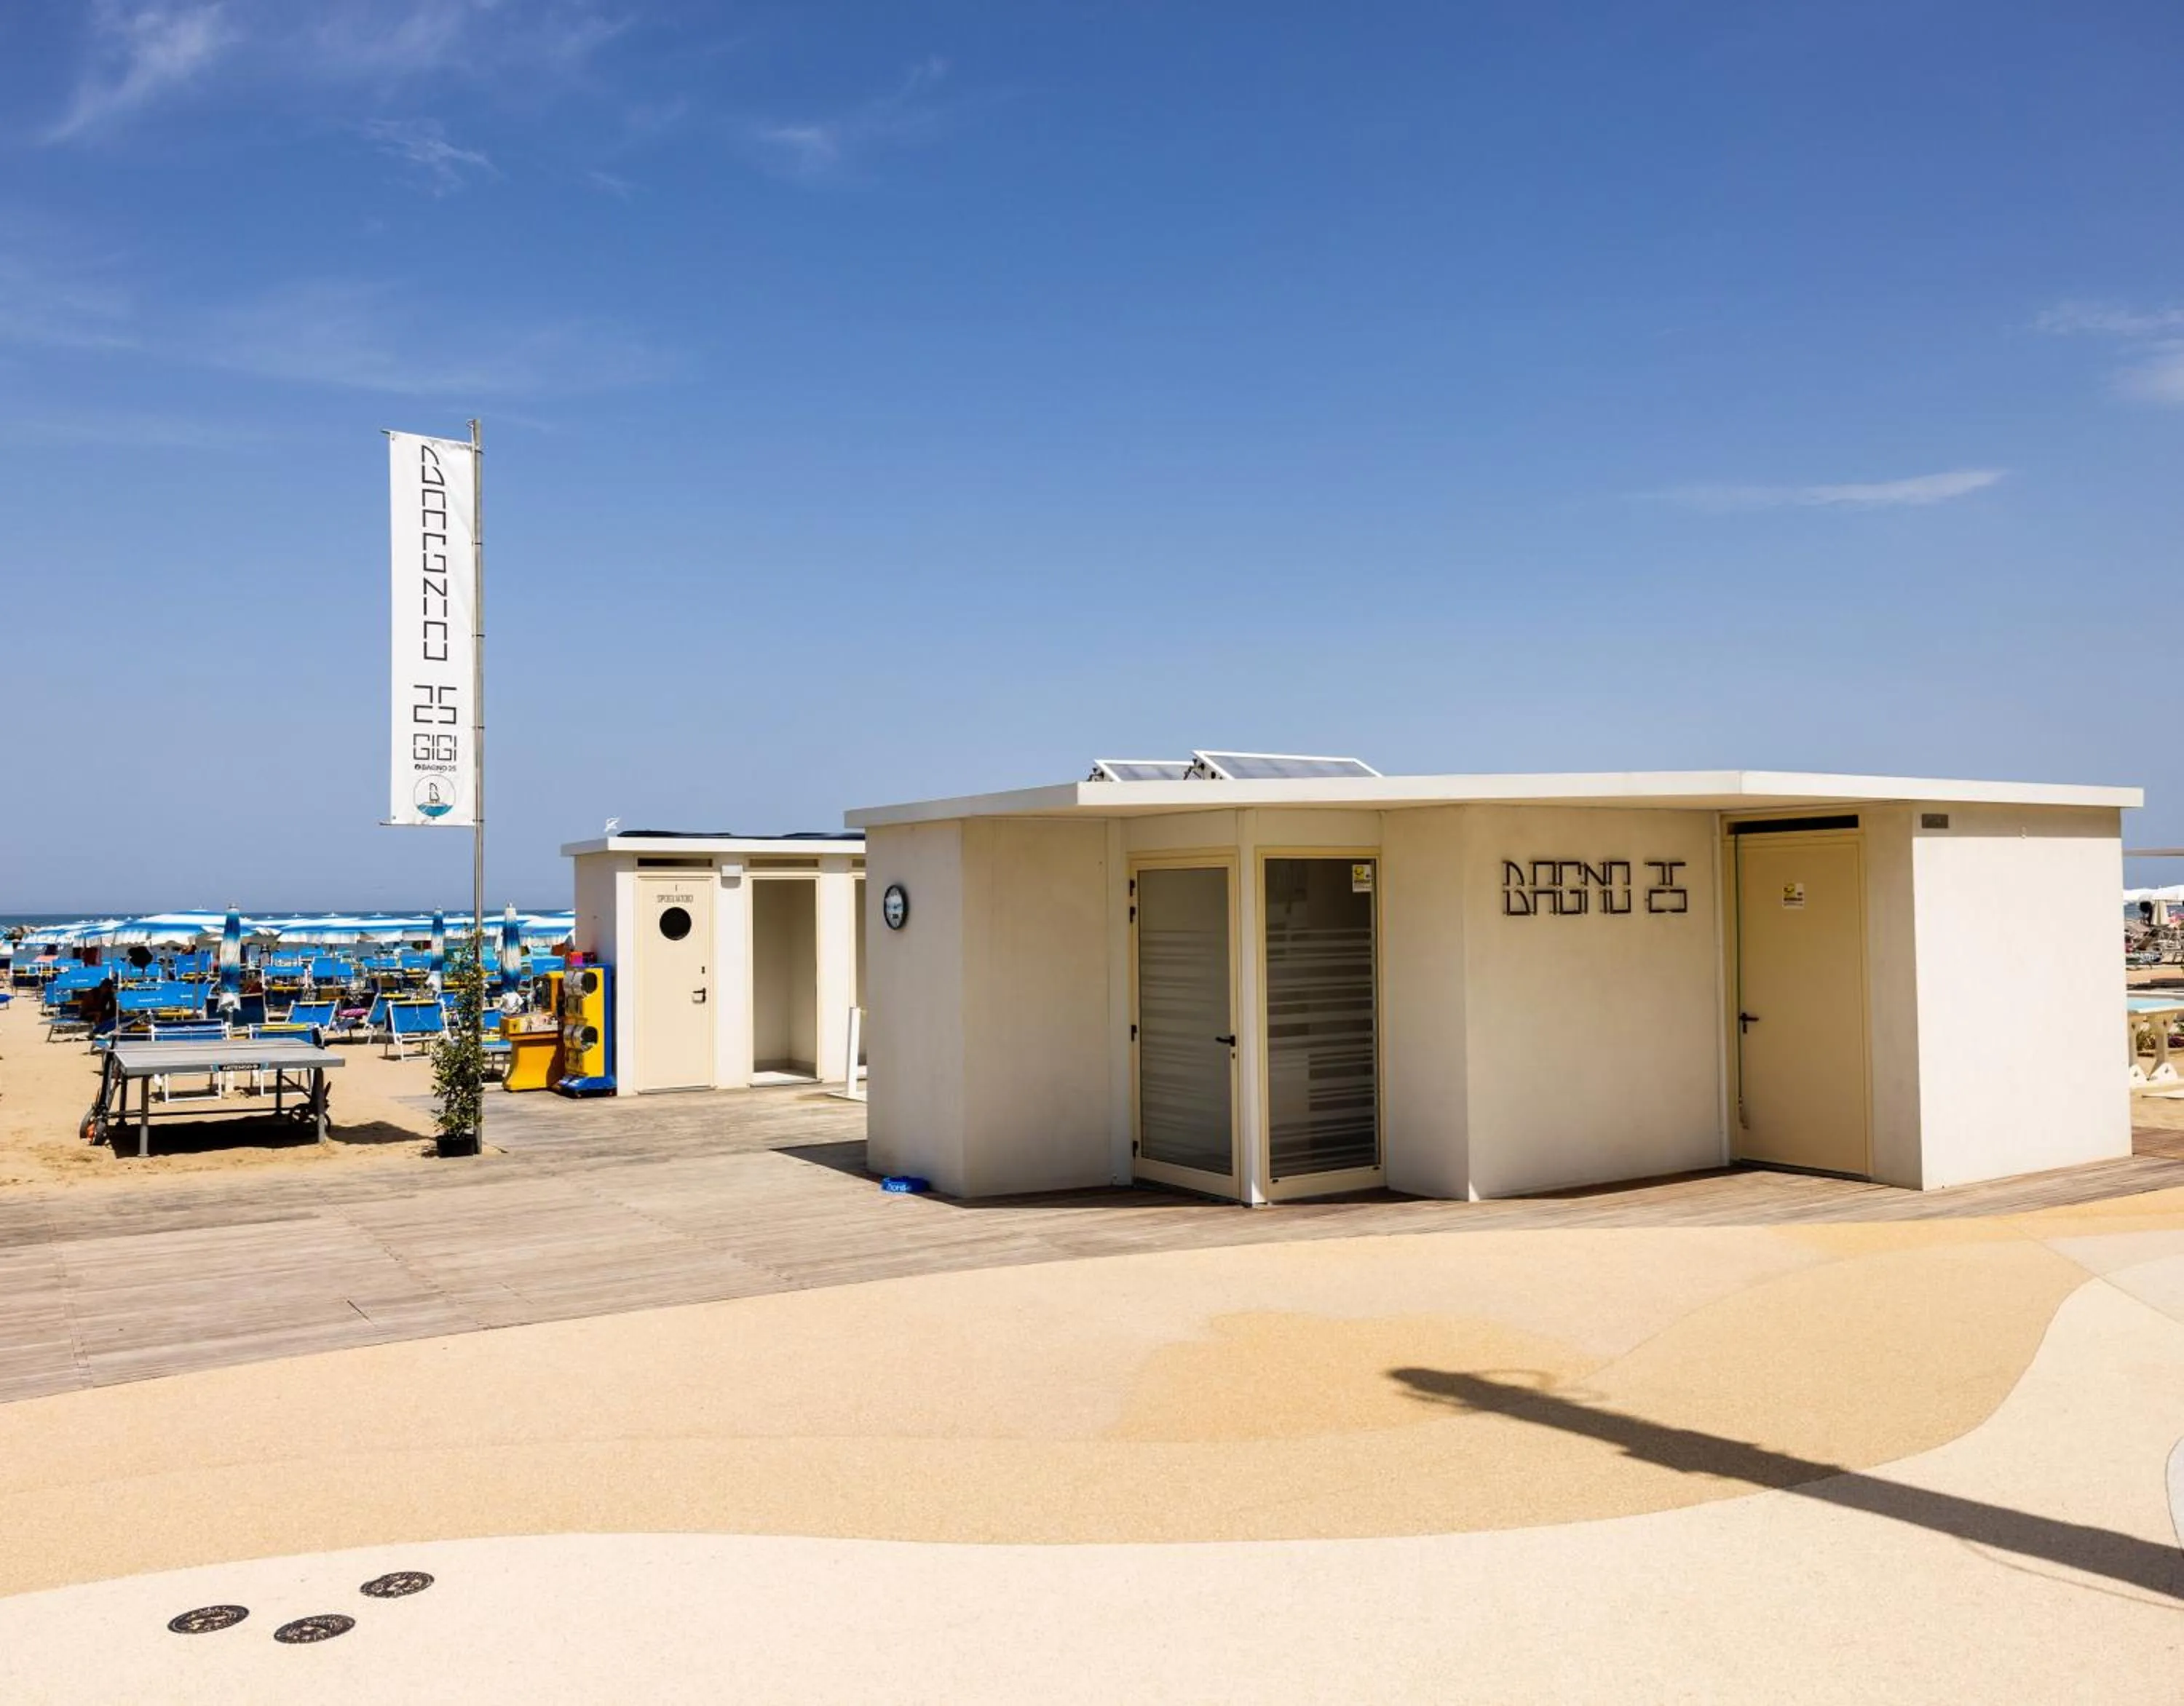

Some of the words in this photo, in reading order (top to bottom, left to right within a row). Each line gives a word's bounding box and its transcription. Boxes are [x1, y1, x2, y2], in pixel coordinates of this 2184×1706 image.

[422, 445, 448, 661] BAGNO
[414, 685, 456, 725] 25
[413, 734, 457, 761] GIGI
[1504, 861, 1631, 916] BAGNO
[1646, 861, 1688, 913] 25
